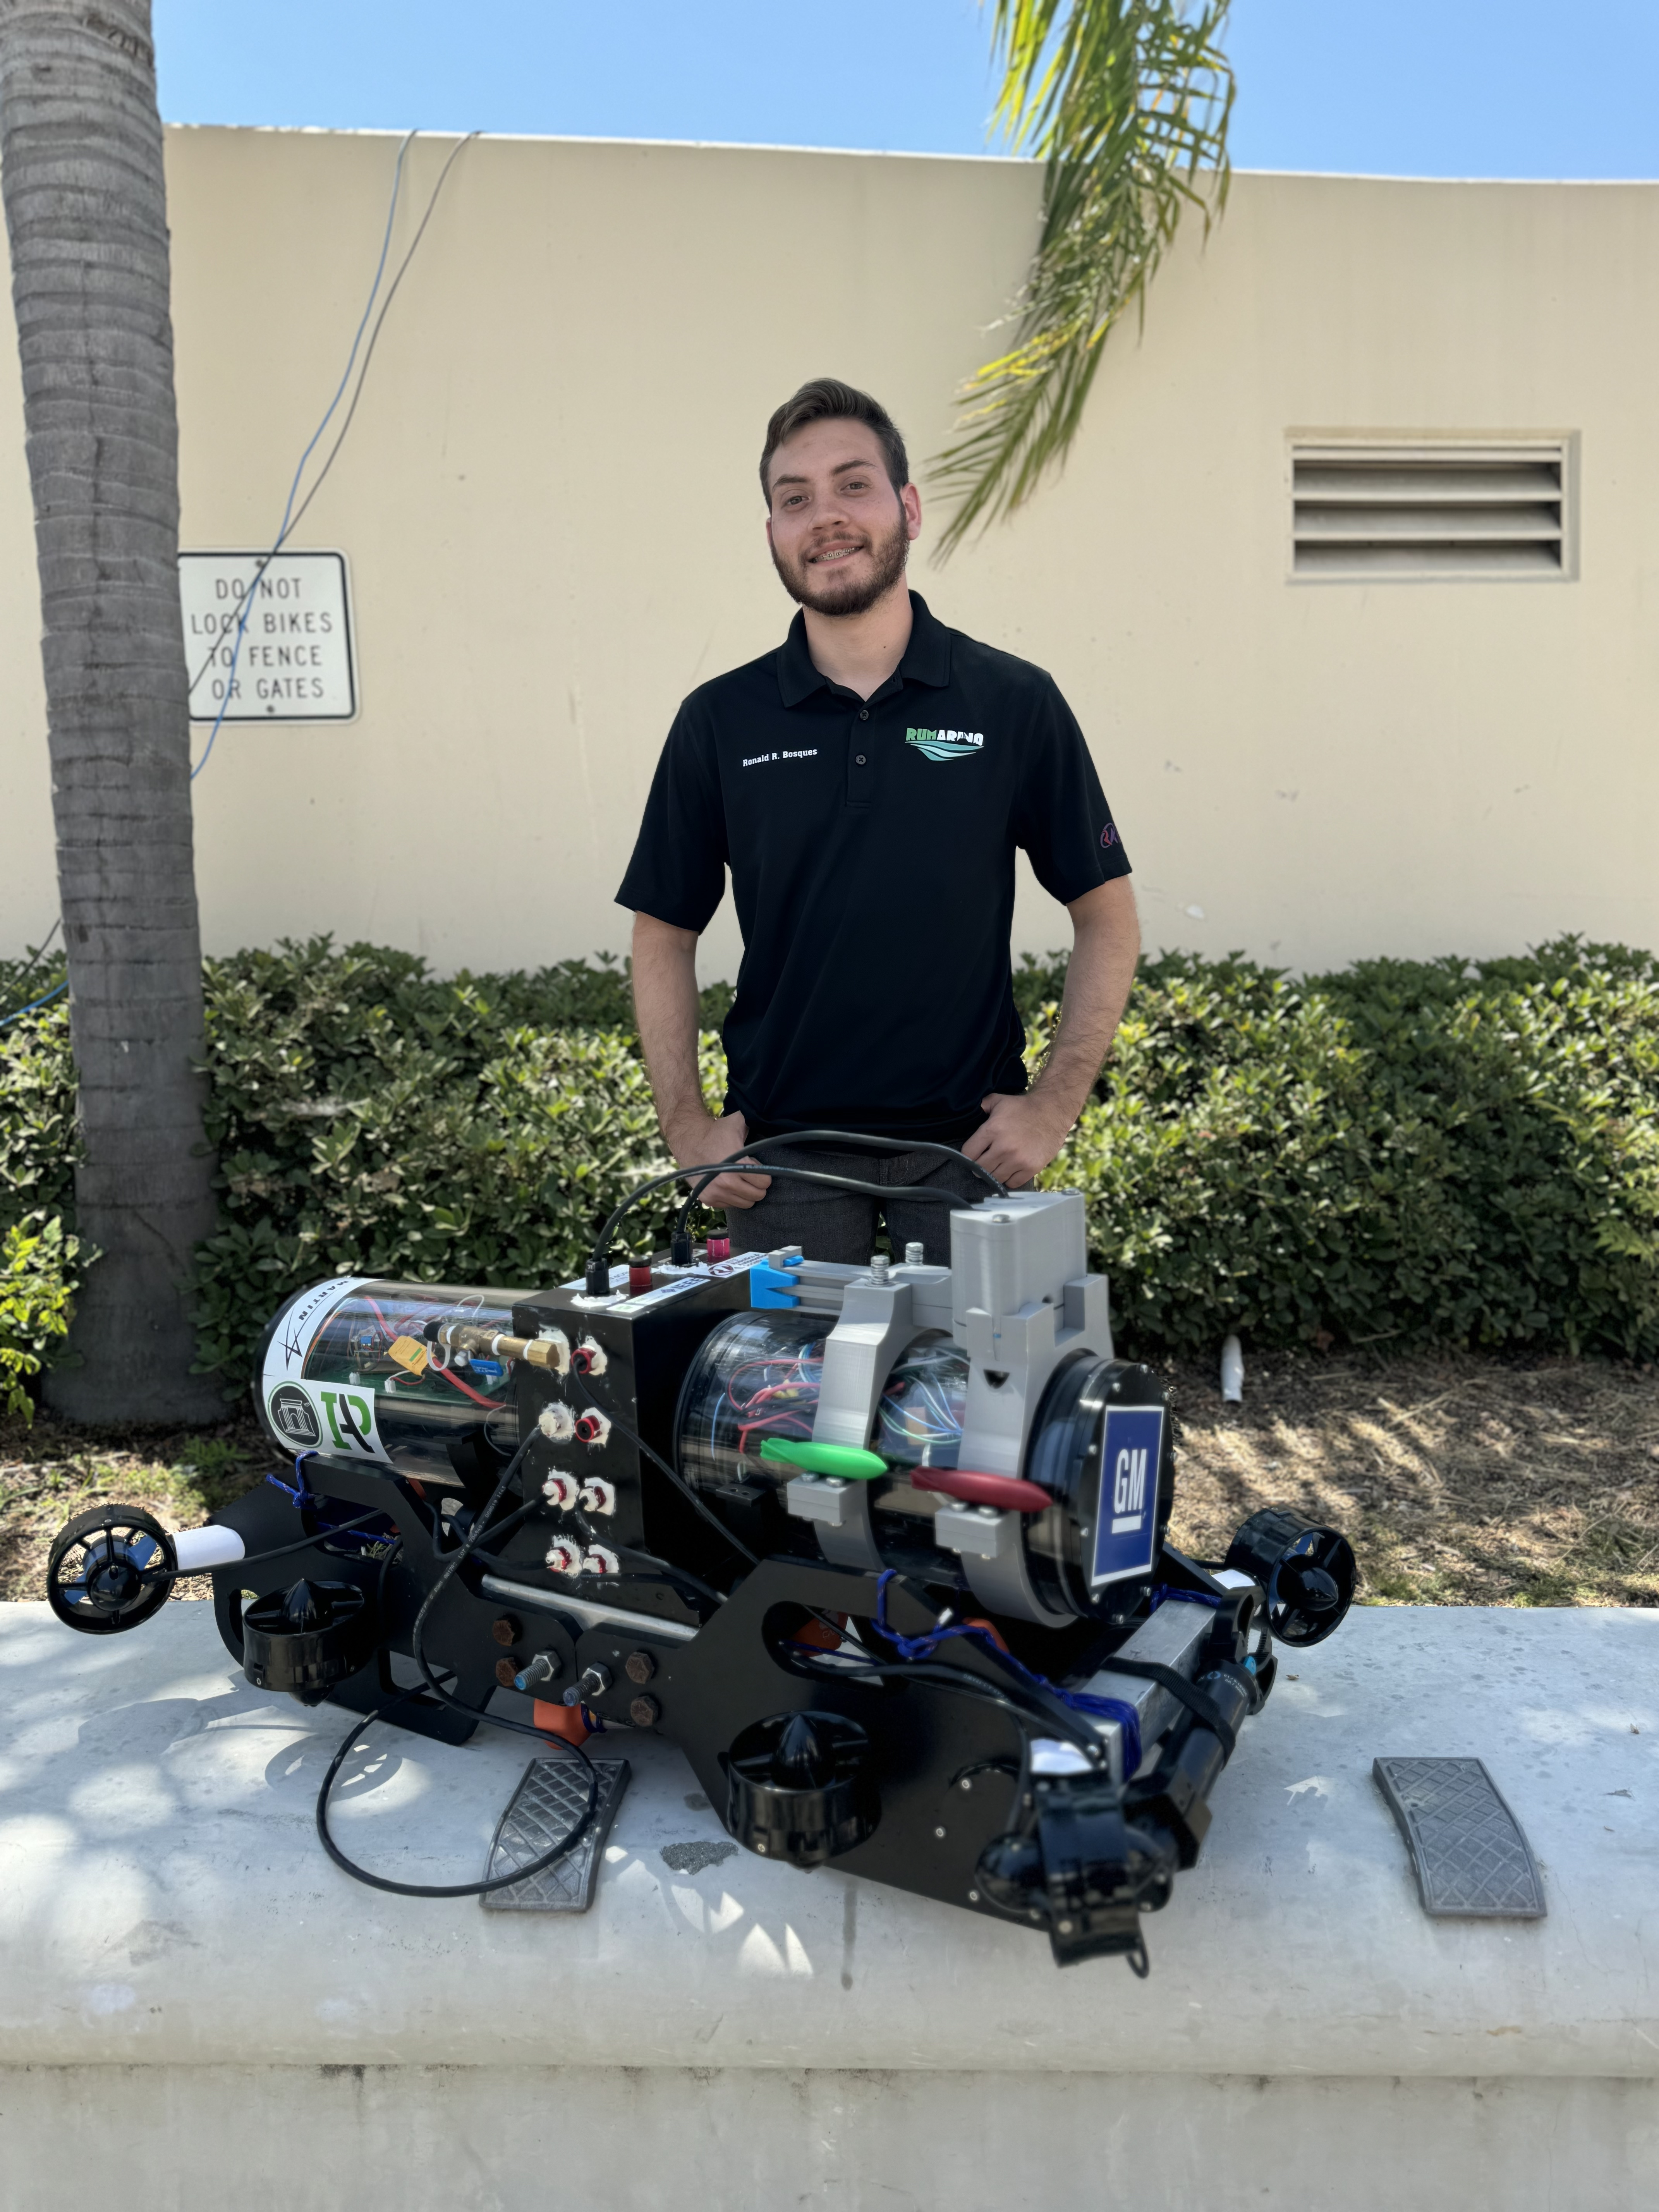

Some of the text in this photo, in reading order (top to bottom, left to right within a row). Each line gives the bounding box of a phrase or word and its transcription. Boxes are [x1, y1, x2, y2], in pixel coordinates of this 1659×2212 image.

[215, 578, 301, 599] DO NOT
[191, 612, 332, 635] LOCK BIKES
[207, 645, 322, 667] TO FENCE
[211, 677, 324, 700] OR GATES
[743, 754, 769, 767] Ronald
[783, 749, 817, 758] Bosques
[675, 1278, 705, 1289] IEEE
[1114, 1448, 1147, 1514] GM
[458, 1549, 466, 1559] LOT
